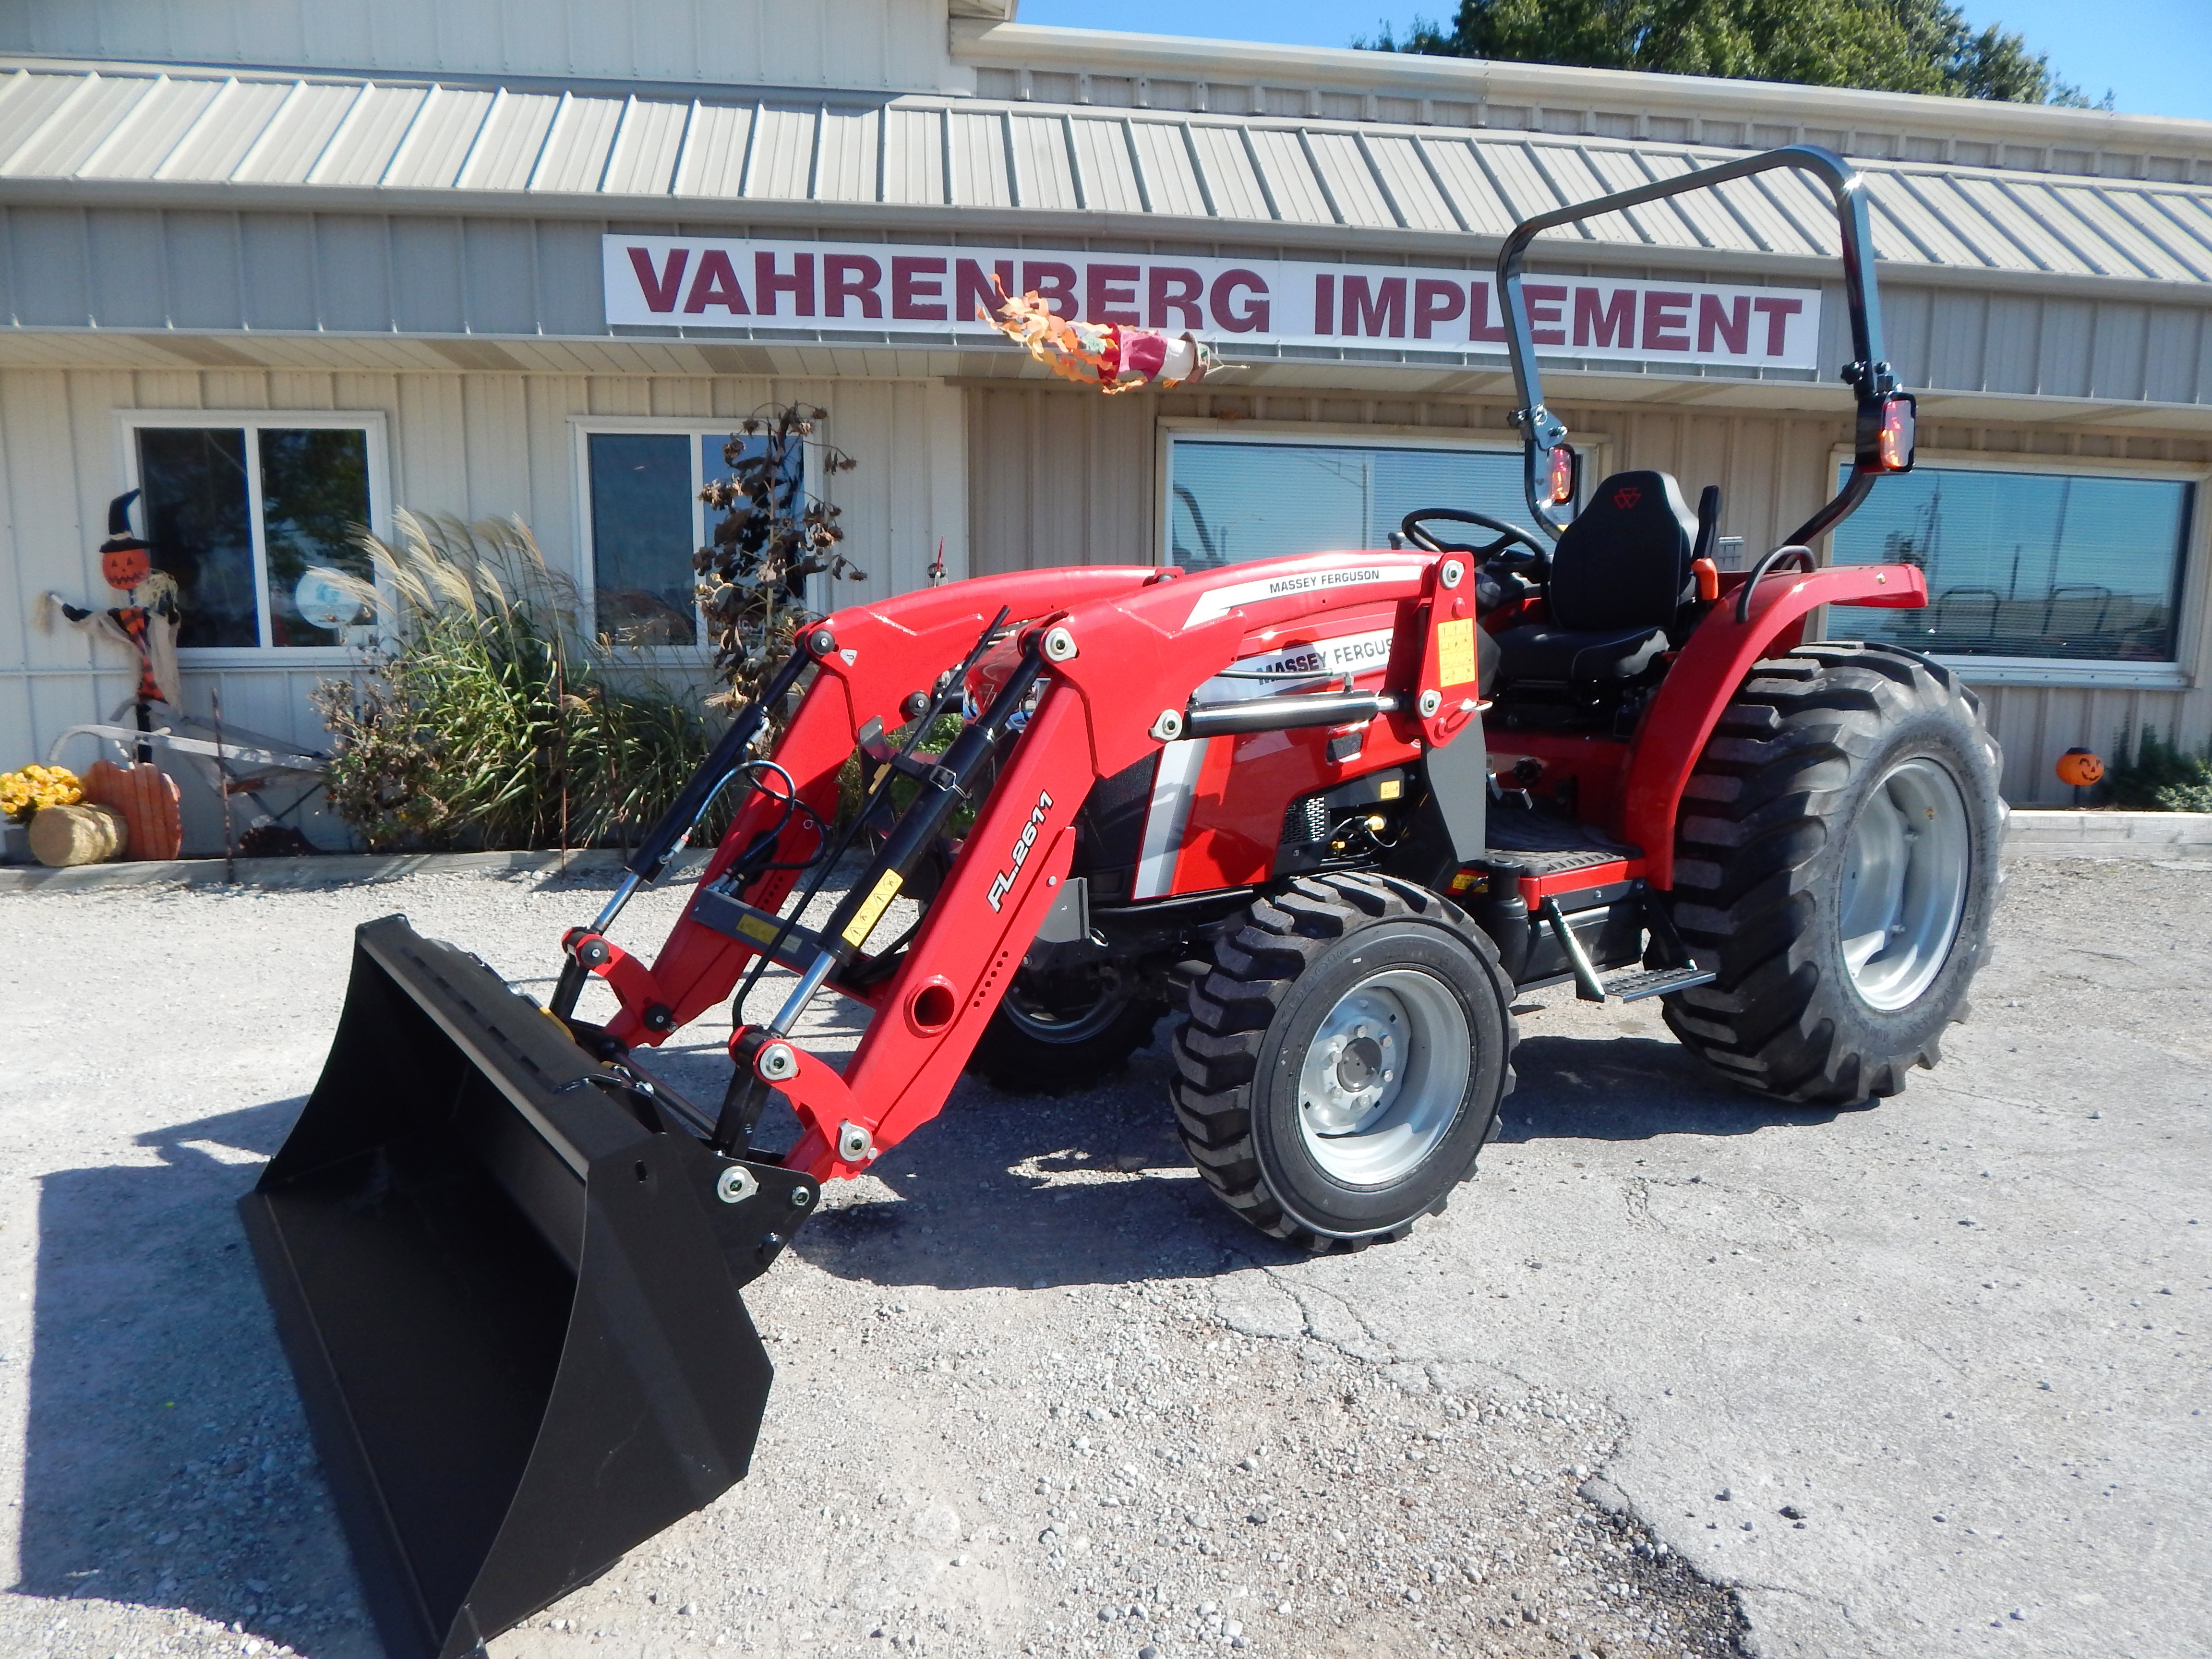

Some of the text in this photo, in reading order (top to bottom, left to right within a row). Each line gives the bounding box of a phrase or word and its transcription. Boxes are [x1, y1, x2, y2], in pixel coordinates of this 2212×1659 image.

[627, 247, 1803, 357] VAHRENBERG IMPLEMENT
[1270, 570, 1380, 594] MASSEY FERGUSON
